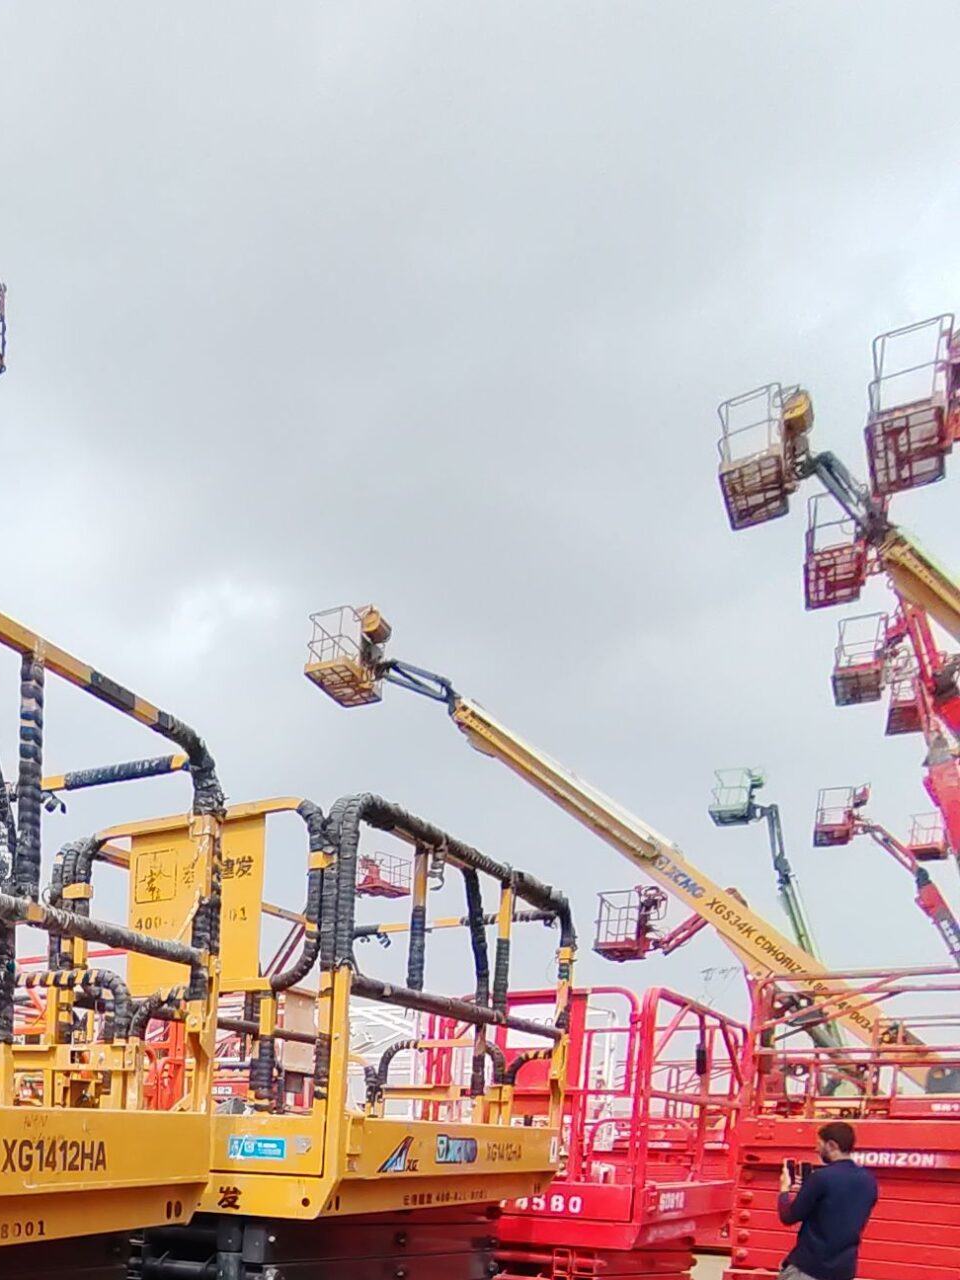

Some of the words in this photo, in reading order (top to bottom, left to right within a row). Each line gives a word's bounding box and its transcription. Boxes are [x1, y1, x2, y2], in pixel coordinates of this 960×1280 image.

[664, 865, 706, 899] XCMG
[705, 897, 758, 938] XGS34K
[1, 1138, 107, 1173] XG1412HA
